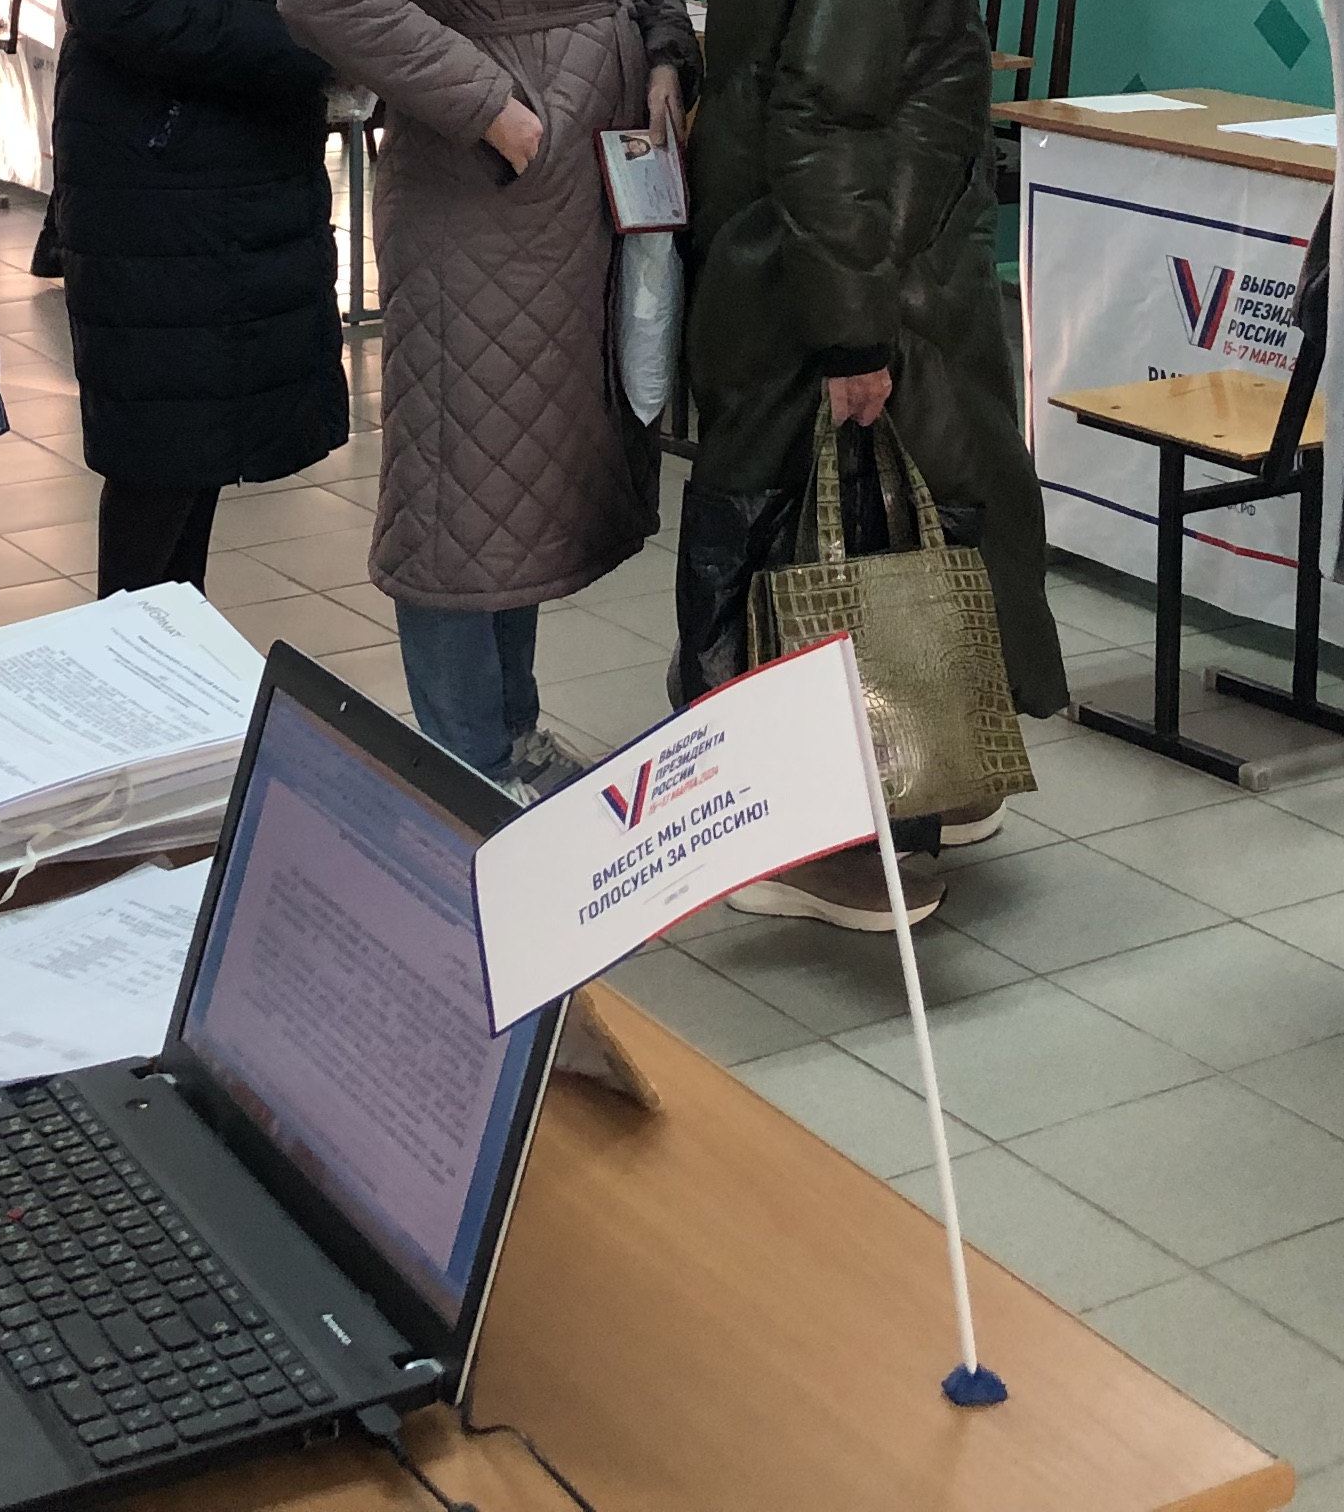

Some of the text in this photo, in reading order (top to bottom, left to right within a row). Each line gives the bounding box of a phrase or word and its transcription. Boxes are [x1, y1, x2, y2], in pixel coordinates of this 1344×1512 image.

[1239, 274, 1296, 300] ВЫБОР
[1234, 297, 1300, 328] ПРЕЗИД
[1228, 319, 1288, 348] РОССИИ
[1249, 348, 1290, 369] МАРТА
[655, 731, 726, 783] ПРЕЗИДЕНТА
[658, 724, 709, 764] ВЫБОРЫ
[651, 763, 696, 800] РОССИИ
[592, 836, 655, 891] ВМЕСТЕ
[658, 816, 687, 847] МЫ
[690, 790, 736, 826] СИЛА
[578, 799, 770, 925] ГОЛОСУЕМ ЗА РОССИЮ!
